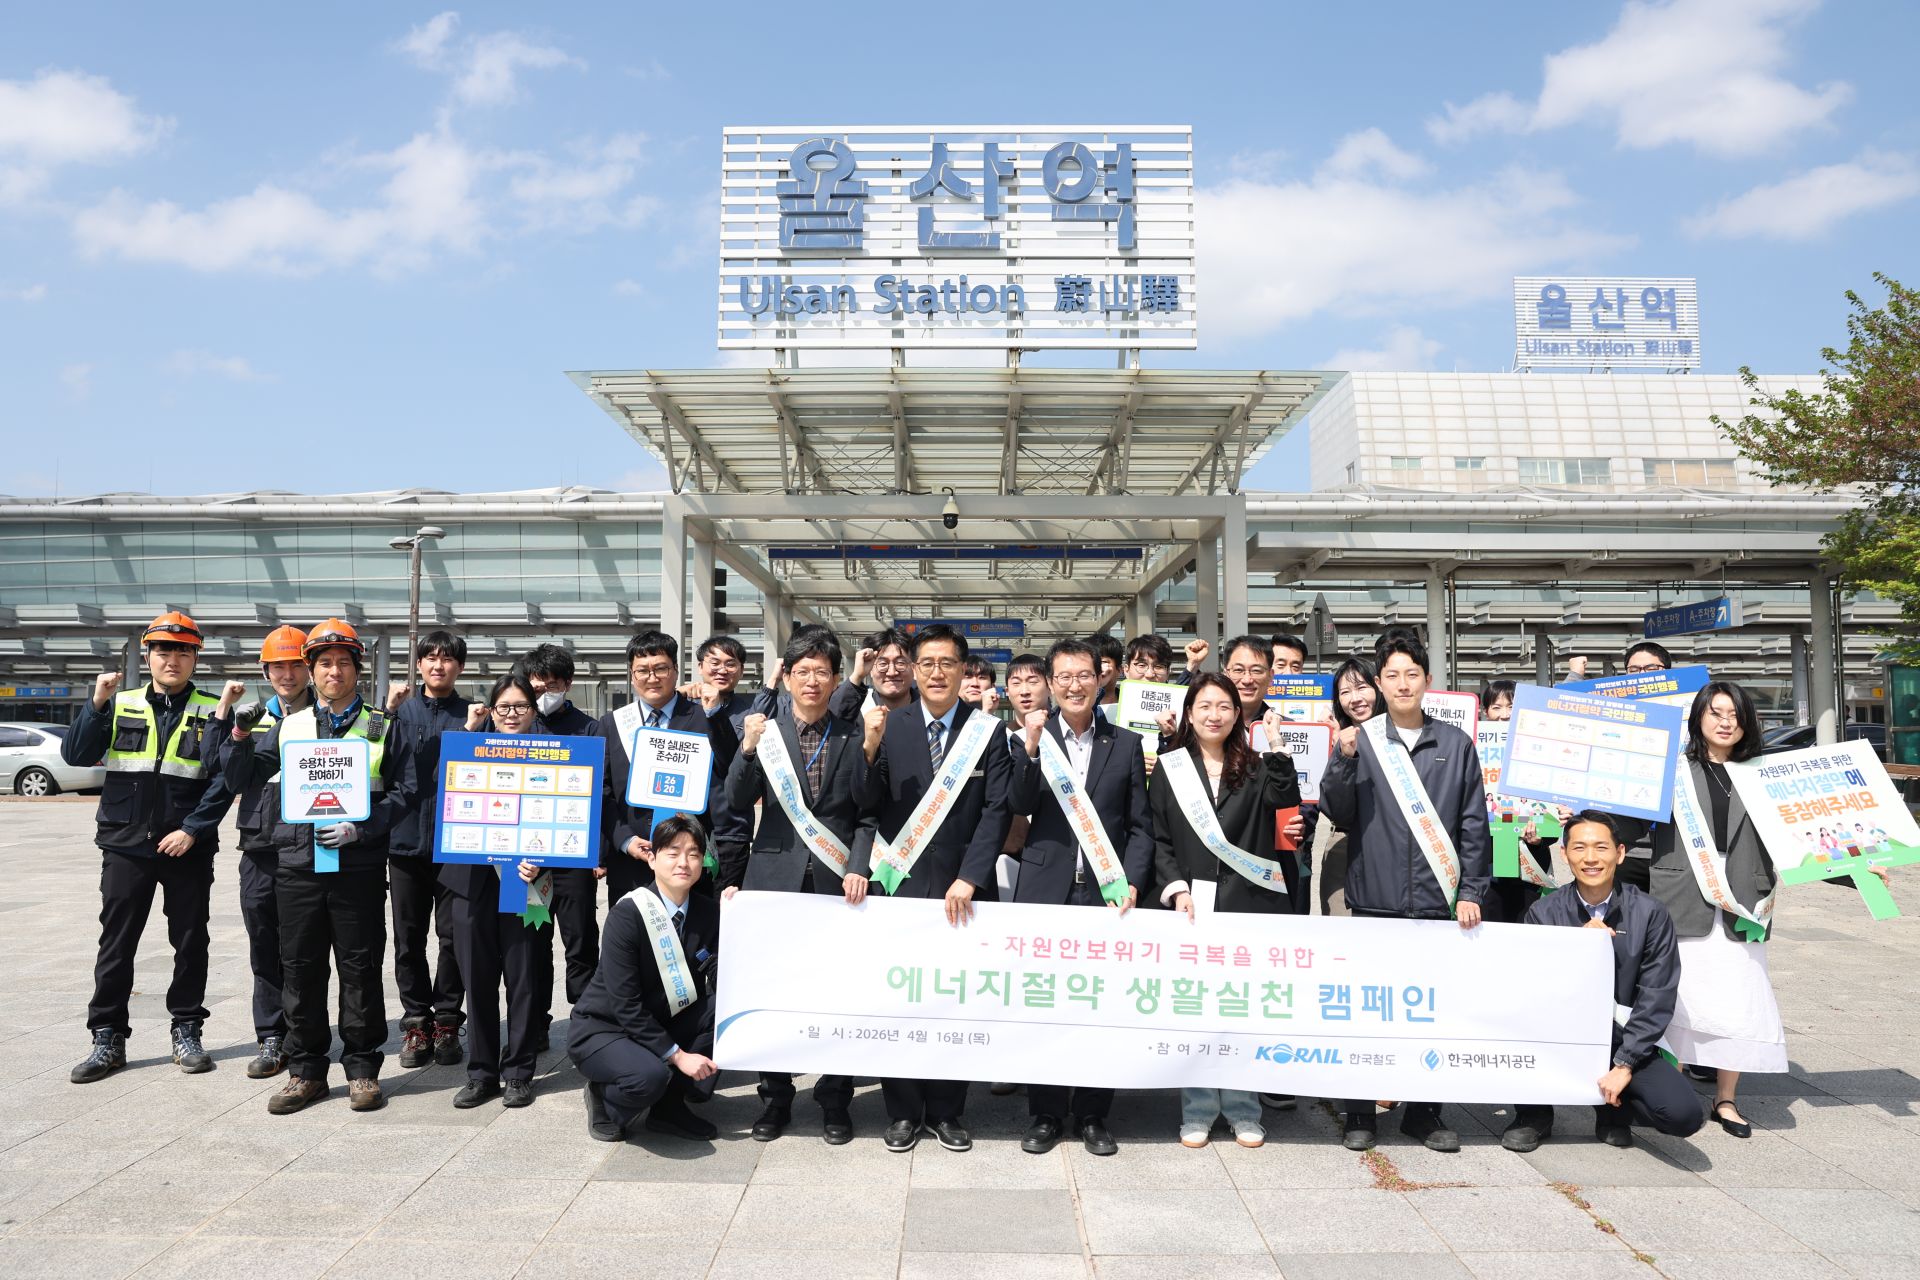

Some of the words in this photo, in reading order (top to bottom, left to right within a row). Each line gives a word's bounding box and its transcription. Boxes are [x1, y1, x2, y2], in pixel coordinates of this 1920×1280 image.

[776, 138, 1134, 251] 울산역
[739, 275, 857, 315] Ulsan
[873, 274, 1026, 314] Station
[1053, 274, 1179, 314] 蔚山驛
[1536, 283, 1678, 331] 울산역
[1525, 338, 1571, 354] Ulsan
[1576, 339, 1635, 354] Station
[1286, 686, 1323, 696] 국민행동
[1637, 681, 1678, 694] 국민행동
[1141, 690, 1172, 703] 대중교통
[1140, 701, 1171, 712] 이용하기
[1440, 708, 1466, 720] 에너지
[1547, 699, 1601, 716] 에너지절약
[1602, 707, 1646, 723] 국민행동
[1280, 731, 1309, 743] 필요한
[313, 746, 338, 756] 요일제
[474, 746, 528, 759] 에너지절약
[528, 748, 571, 761] 국민행동
[649, 737, 666, 749] 적정
[667, 740, 700, 754] 실내온도
[298, 758, 326, 769] 승용차
[328, 756, 353, 768] 5부제
[656, 750, 689, 764] 준수하기
[941, 722, 986, 792] 에너지절약에
[308, 769, 344, 780] 참여하기
[1758, 762, 1801, 779] 자원위기
[1799, 757, 1832, 772] 극복을
[1831, 754, 1854, 767] 위한
[664, 775, 676, 784] 26
[1383, 742, 1426, 815] 에너지절약에
[1764, 768, 1868, 801] 에너지절약에
[663, 785, 675, 793] 20
[1777, 790, 1879, 825] 동참해주세요
[896, 788, 948, 860] 동참해주세요
[1068, 795, 1112, 872] 동참해주세요
[1004, 936, 1161, 963] 자원안보위기
[1179, 943, 1252, 967] 극복을
[1268, 946, 1315, 969] 위한
[659, 935, 690, 1008] 에너지절약에
[887, 966, 1105, 1010] 에너지절약
[1126, 977, 1294, 1019] 생활실천
[1318, 984, 1435, 1023] 캠페인
[855, 1028, 899, 1042] 2026년
[907, 1030, 928, 1043] 4월
[1254, 1043, 1344, 1065] KORAIL
[1349, 1053, 1397, 1066] 한국철도
[1448, 1053, 1537, 1069] 한국에너지공단
